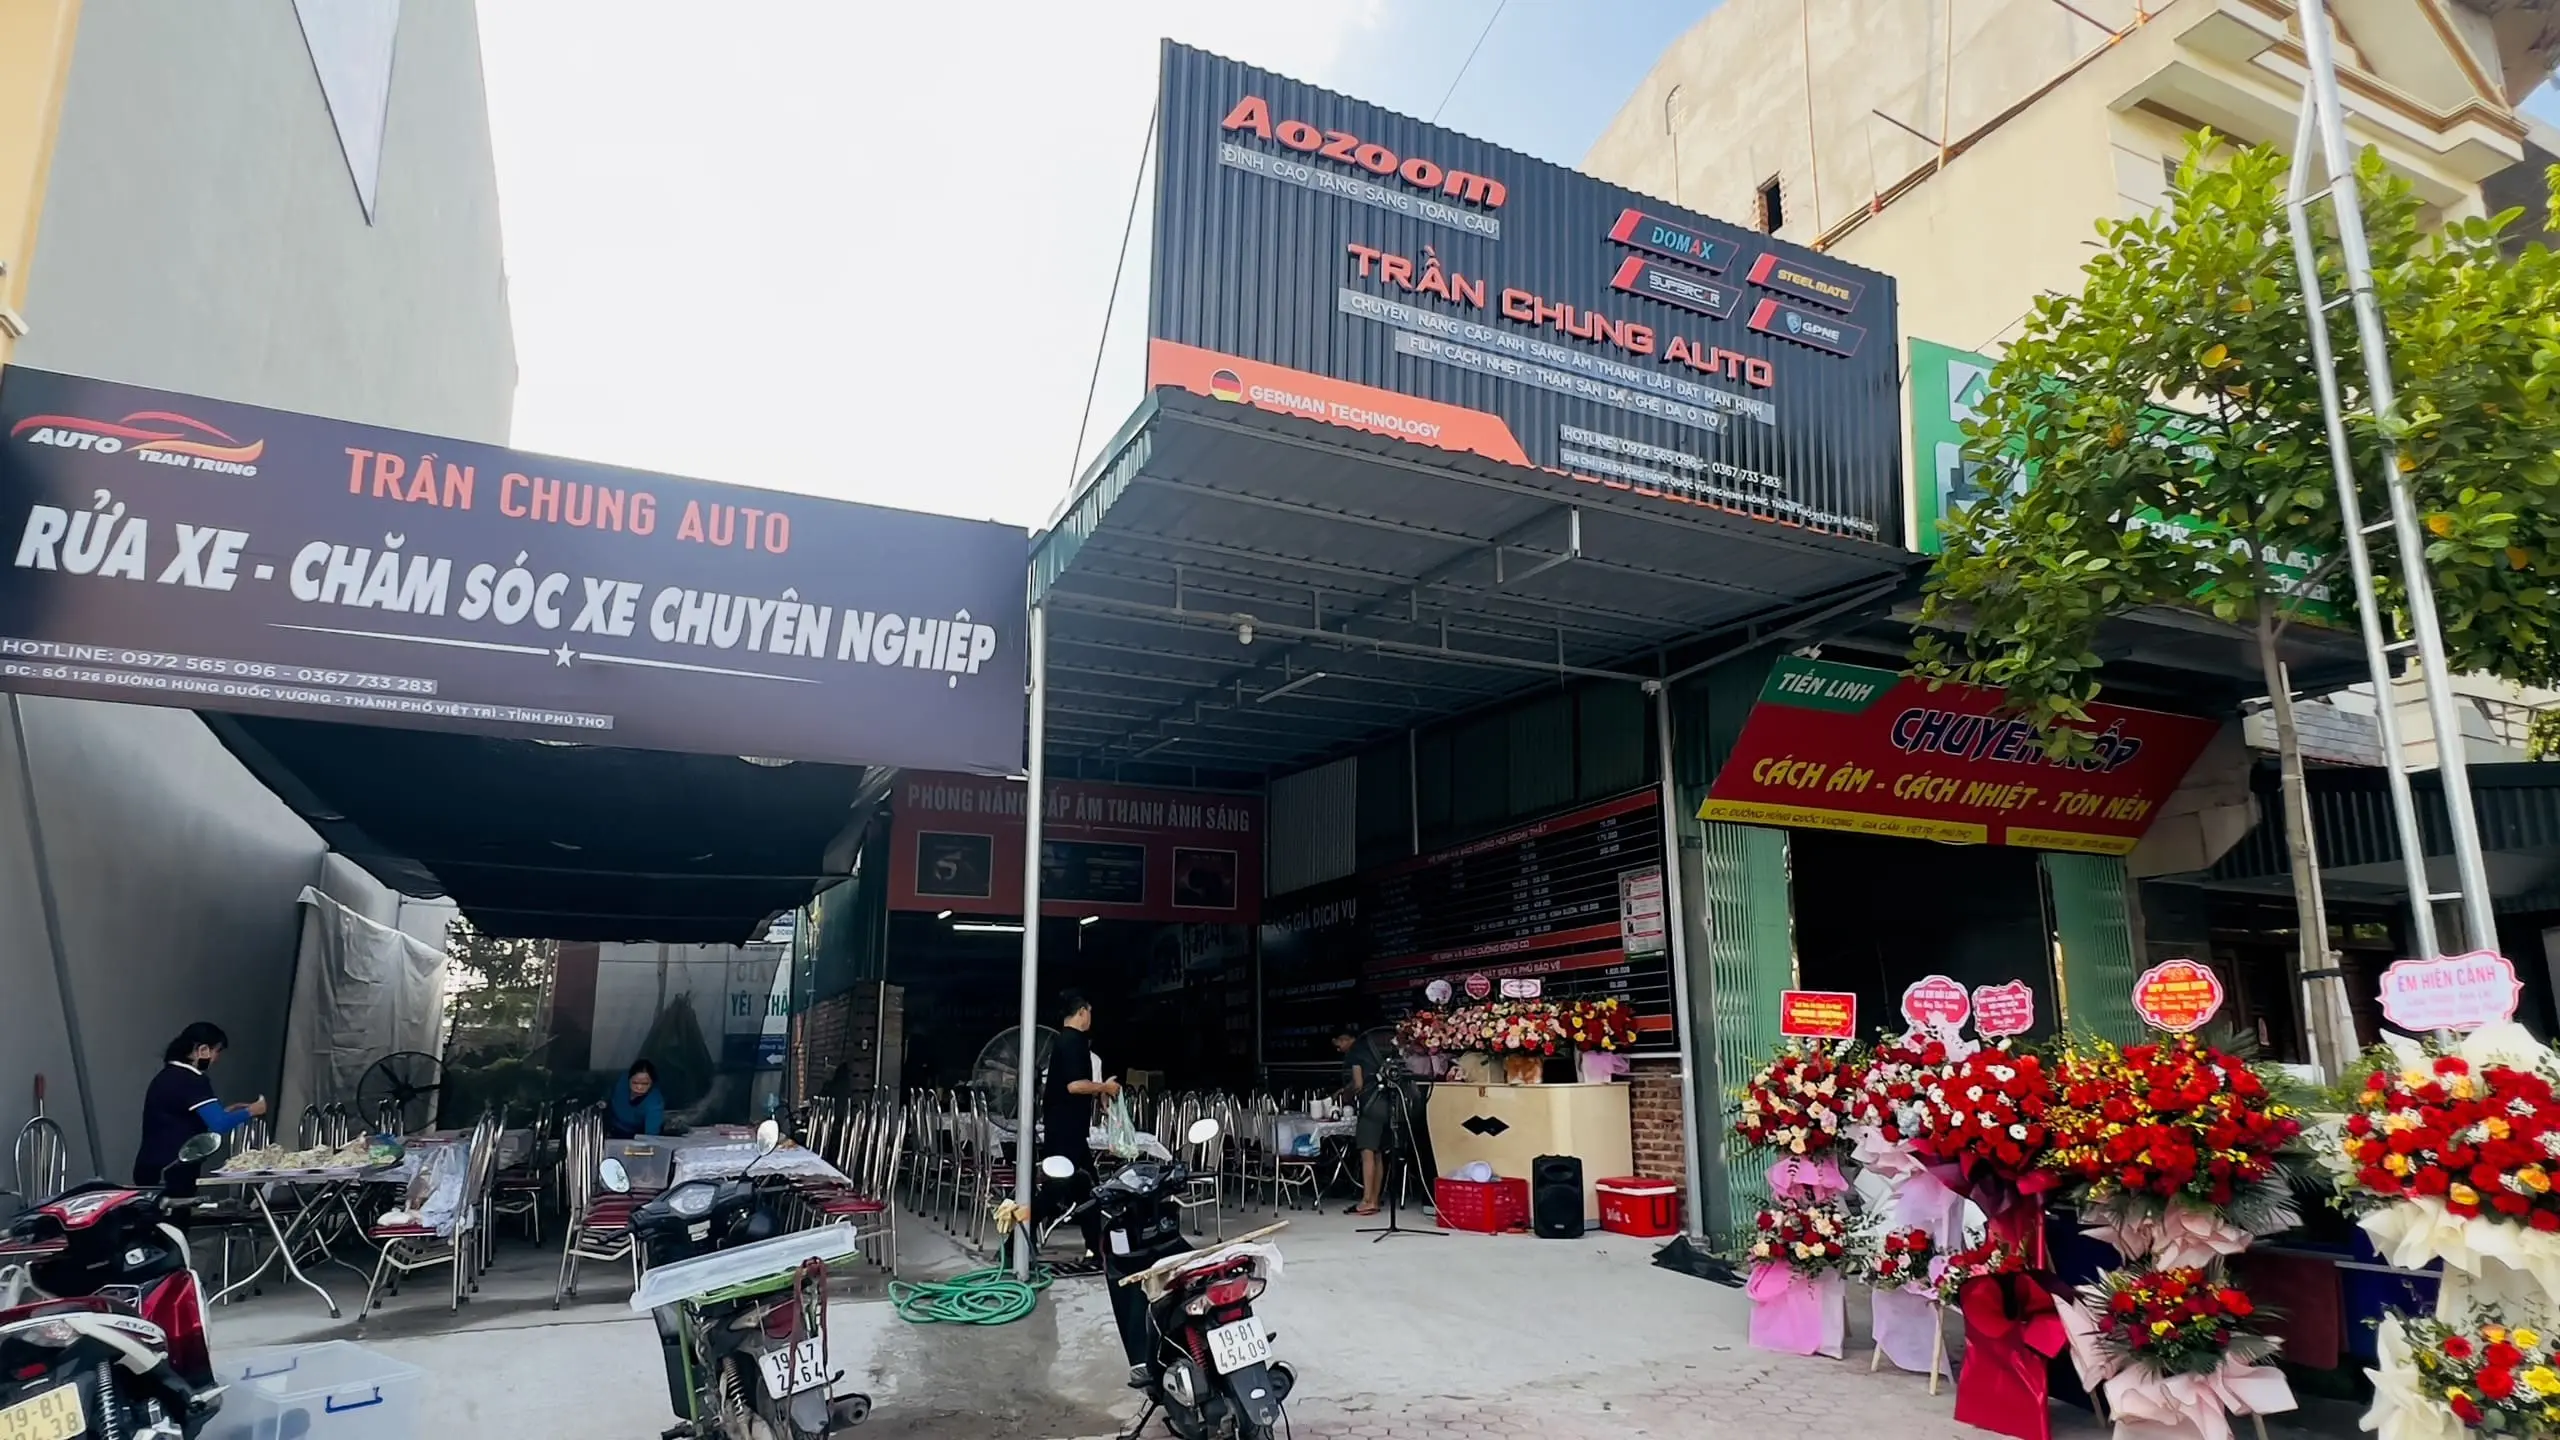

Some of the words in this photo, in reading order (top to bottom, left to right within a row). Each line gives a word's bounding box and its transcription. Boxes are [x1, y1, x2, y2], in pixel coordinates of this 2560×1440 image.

[1273, 162, 1308, 181] CAO
[1366, 185, 1408, 210] SÁNG
[1417, 200, 1458, 225] TOÀN
[1651, 226, 1713, 260] DOMAX
[1348, 243, 1485, 310] TRẦN
[1502, 287, 1654, 355] CHUNG
[1664, 335, 1773, 388] AUTO
[1802, 321, 1840, 340] GPNE
[1410, 336, 1441, 355] FILM
[1444, 345, 1482, 368] CÁCH
[1486, 355, 1524, 379] NHIỆT
[1665, 402, 1681, 417] DA
[1530, 341, 1566, 364] SÁNG
[1597, 361, 1640, 384] THANH
[1249, 385, 1325, 416] GERMAN
[1329, 402, 1440, 440] TECHNOLOGY
[28, 427, 122, 454] AUTO
[138, 449, 190, 468] TRAN
[192, 457, 258, 478] TRUNG
[1622, 439, 1650, 457] 0972
[1654, 446, 1673, 463] 565
[1712, 461, 1738, 478] 0367
[1741, 468, 1760, 484] 733
[1761, 474, 1781, 489] 283
[344, 447, 475, 511] TRẦN
[499, 473, 657, 536] CHUNG
[676, 500, 790, 554] AUTO
[14, 489, 148, 581] RỬA
[156, 523, 249, 591] XE
[254, 563, 274, 580] -
[289, 530, 453, 617] CHĂM
[456, 550, 571, 631] SÓC
[570, 577, 643, 638] XE
[650, 586, 832, 659] CHUYÊN
[837, 608, 996, 689] NGHIỆP
[2, 639, 114, 663] HOTLINE:
[121, 651, 179, 669] 0972
[185, 659, 227, 674] 565
[234, 663, 277, 679] 096
[297, 668, 350, 685] 0367
[356, 672, 391, 690] 733
[397, 676, 433, 694] 283
[1778, 668, 1824, 695] TIẾN
[1825, 680, 1875, 704] LINH
[72, 671, 100, 682] 126
[104, 671, 167, 688] ĐƯỜNG
[171, 678, 220, 694] HÙNG
[223, 681, 271, 699] QUỐC
[344, 694, 397, 711] THÀNH
[1752, 753, 1827, 790] CÁCH
[1825, 761, 1875, 793] ÂM
[1893, 770, 1962, 803] CÁCH
[1960, 780, 2039, 816] NHIỆT
[2053, 788, 2103, 817] TÔN
[2101, 788, 2152, 822] NỀN
[1075, 792, 1103, 822] ÂM
[1107, 798, 1164, 826] THANH
[1205, 803, 1250, 833] SÁNG
[1313, 902, 1339, 933] DỊCH
[1342, 897, 1357, 926] VỤ
[2398, 975, 2418, 992] EM
[1219, 1339, 1267, 1368] 454.09
[3, 1392, 64, 1433] 19-B1
